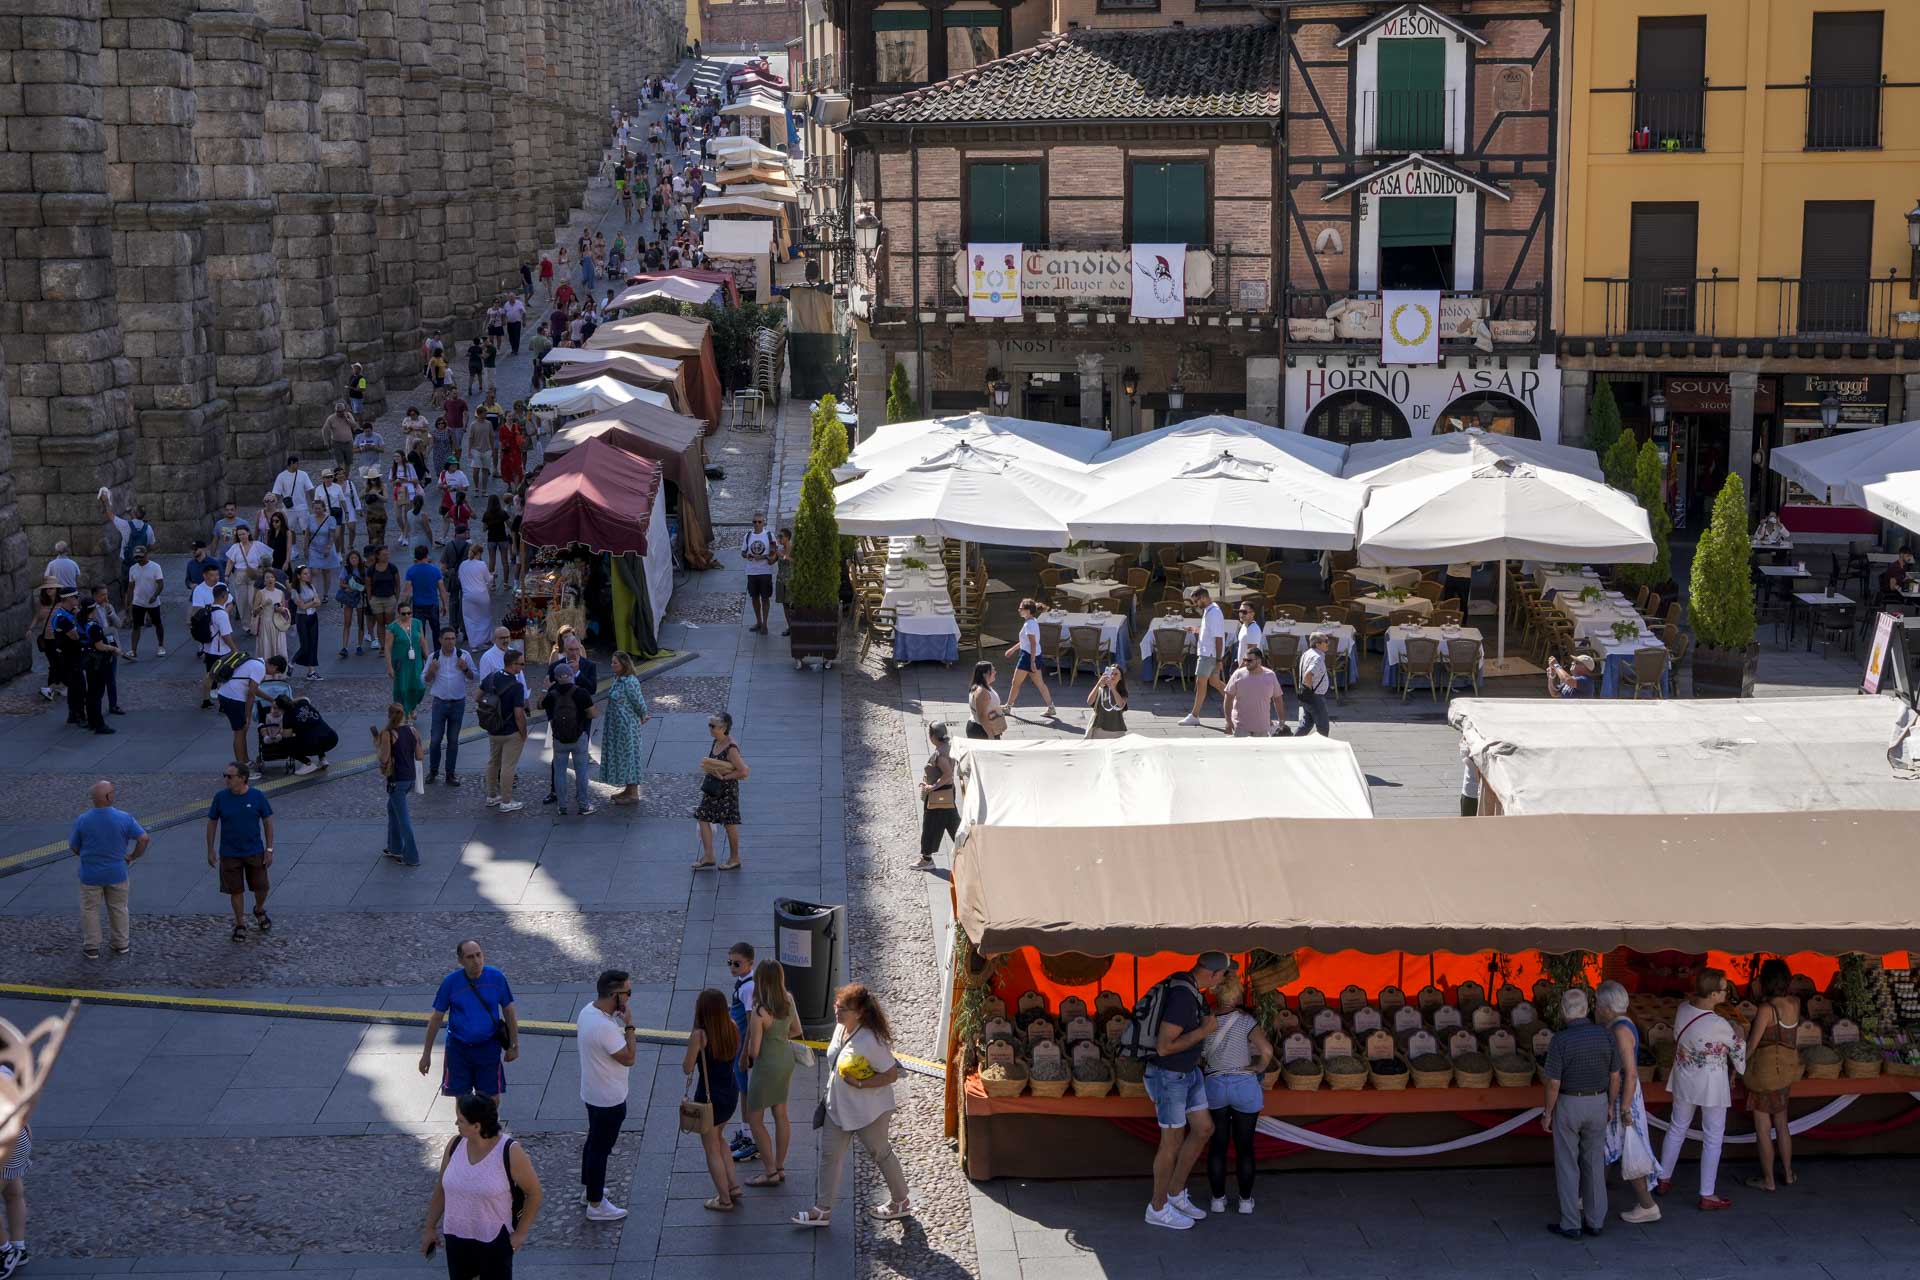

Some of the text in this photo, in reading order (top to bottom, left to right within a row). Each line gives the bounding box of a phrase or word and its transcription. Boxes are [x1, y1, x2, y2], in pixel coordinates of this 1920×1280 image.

[1384, 16, 1440, 36] MESON
[1369, 171, 1465, 195] CASA CANDIDO
[1051, 276, 1104, 294] Mayor
[1110, 279, 1126, 291] de
[1305, 369, 1540, 420] HORNO DE ASAR
[1670, 381, 1769, 394] SOUVER
[1805, 375, 1869, 396] Farggi
